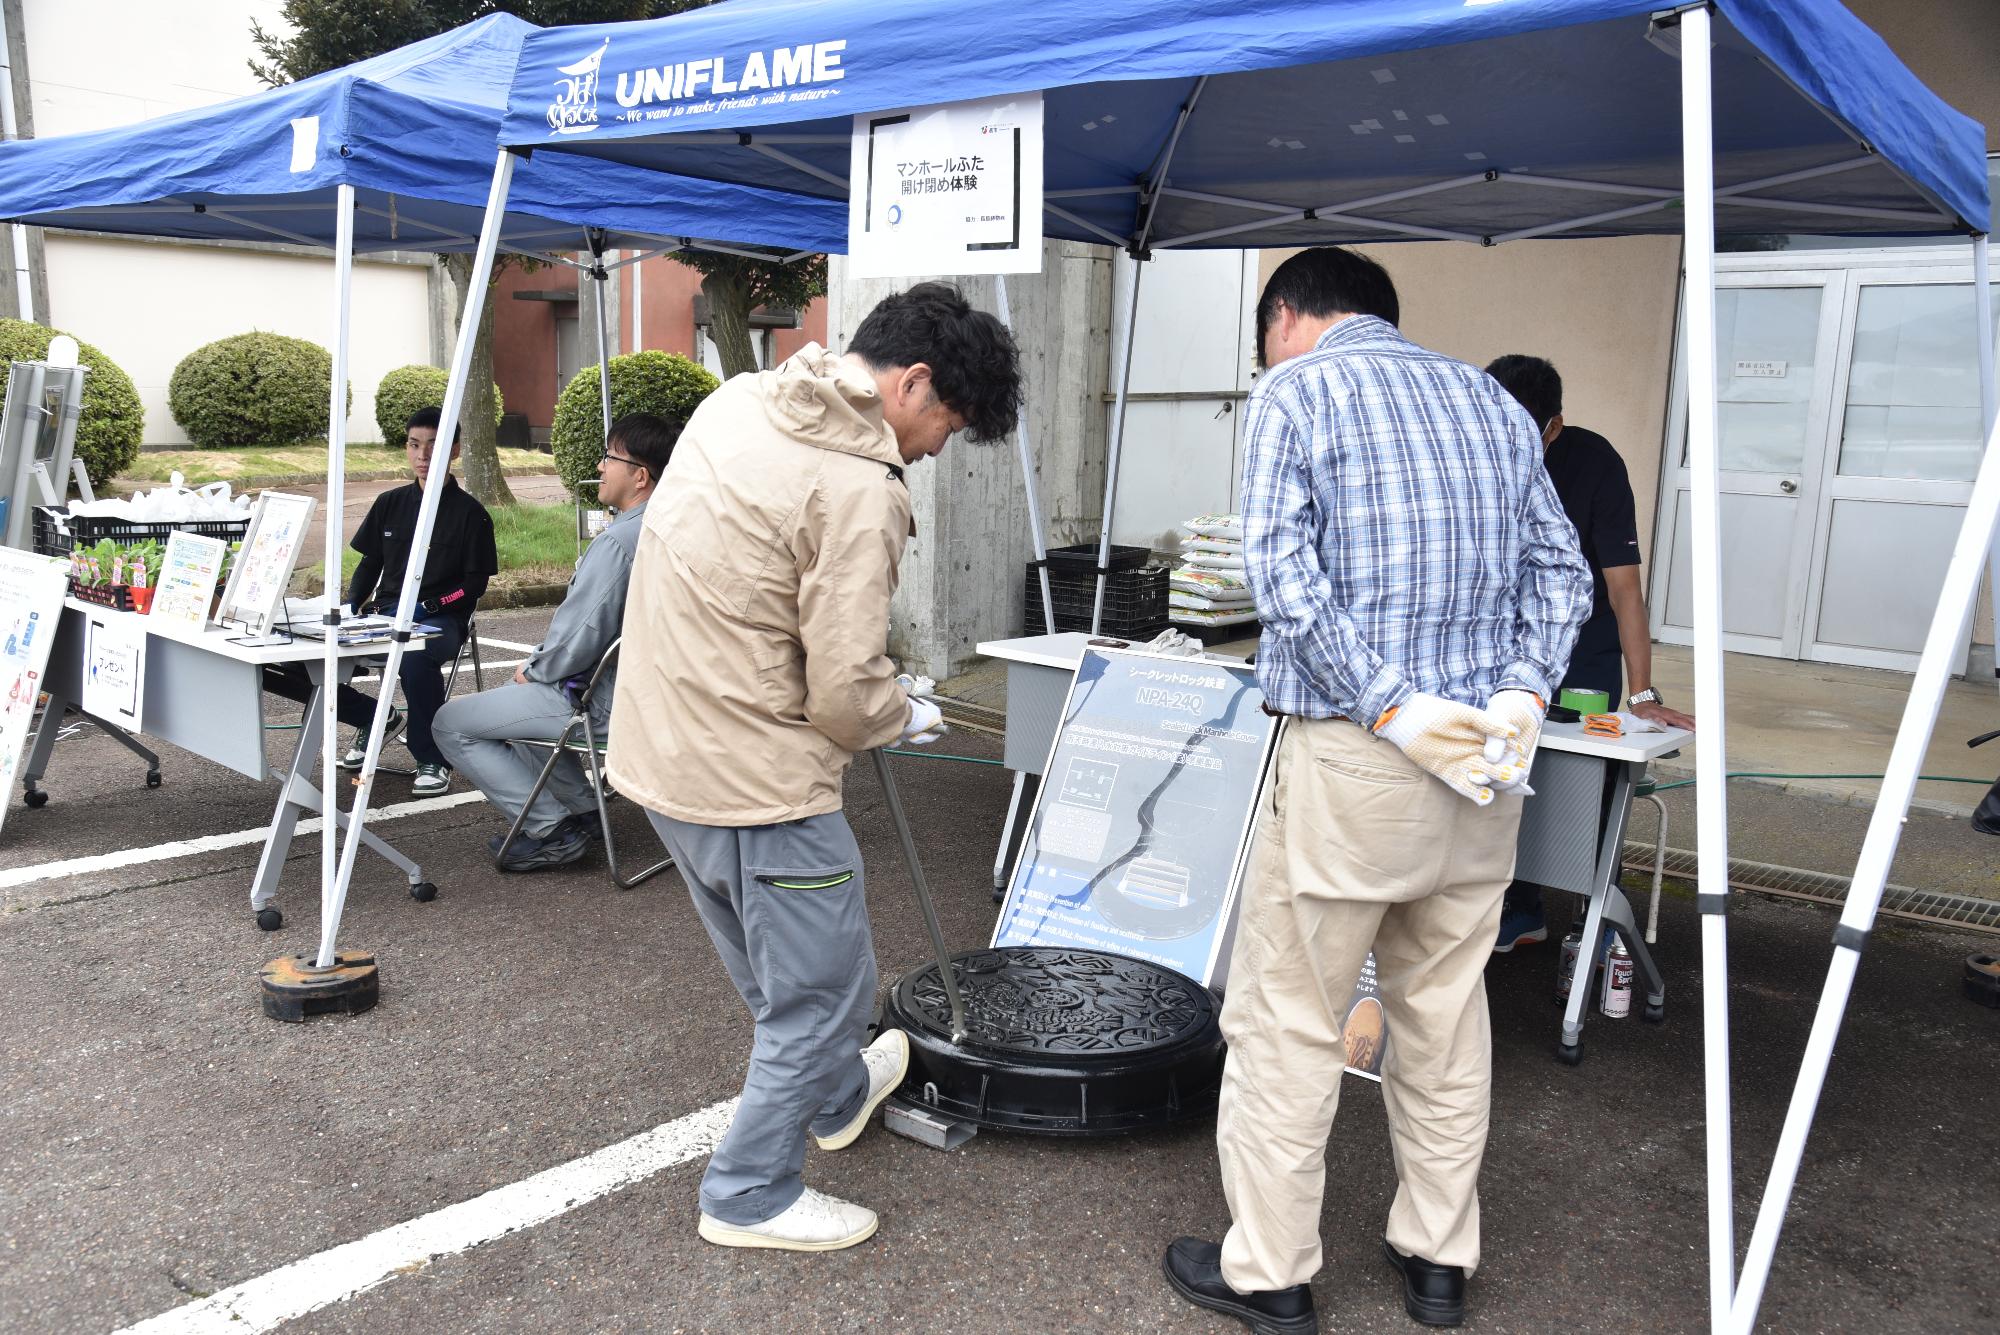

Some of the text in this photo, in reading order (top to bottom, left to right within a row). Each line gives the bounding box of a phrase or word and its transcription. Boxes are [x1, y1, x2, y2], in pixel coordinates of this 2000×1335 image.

[615, 39, 847, 108] UNIFLAME
[646, 107, 671, 120] want
[673, 105, 685, 116] to
[686, 102, 713, 115] make
[715, 96, 758, 114] friends
[760, 93, 786, 105] with
[896, 155, 985, 177] マンホールふた
[901, 174, 978, 196] 開け閉め体験
[1136, 687, 1204, 716] NPA-24Q
[1235, 731, 1258, 744] Cover
